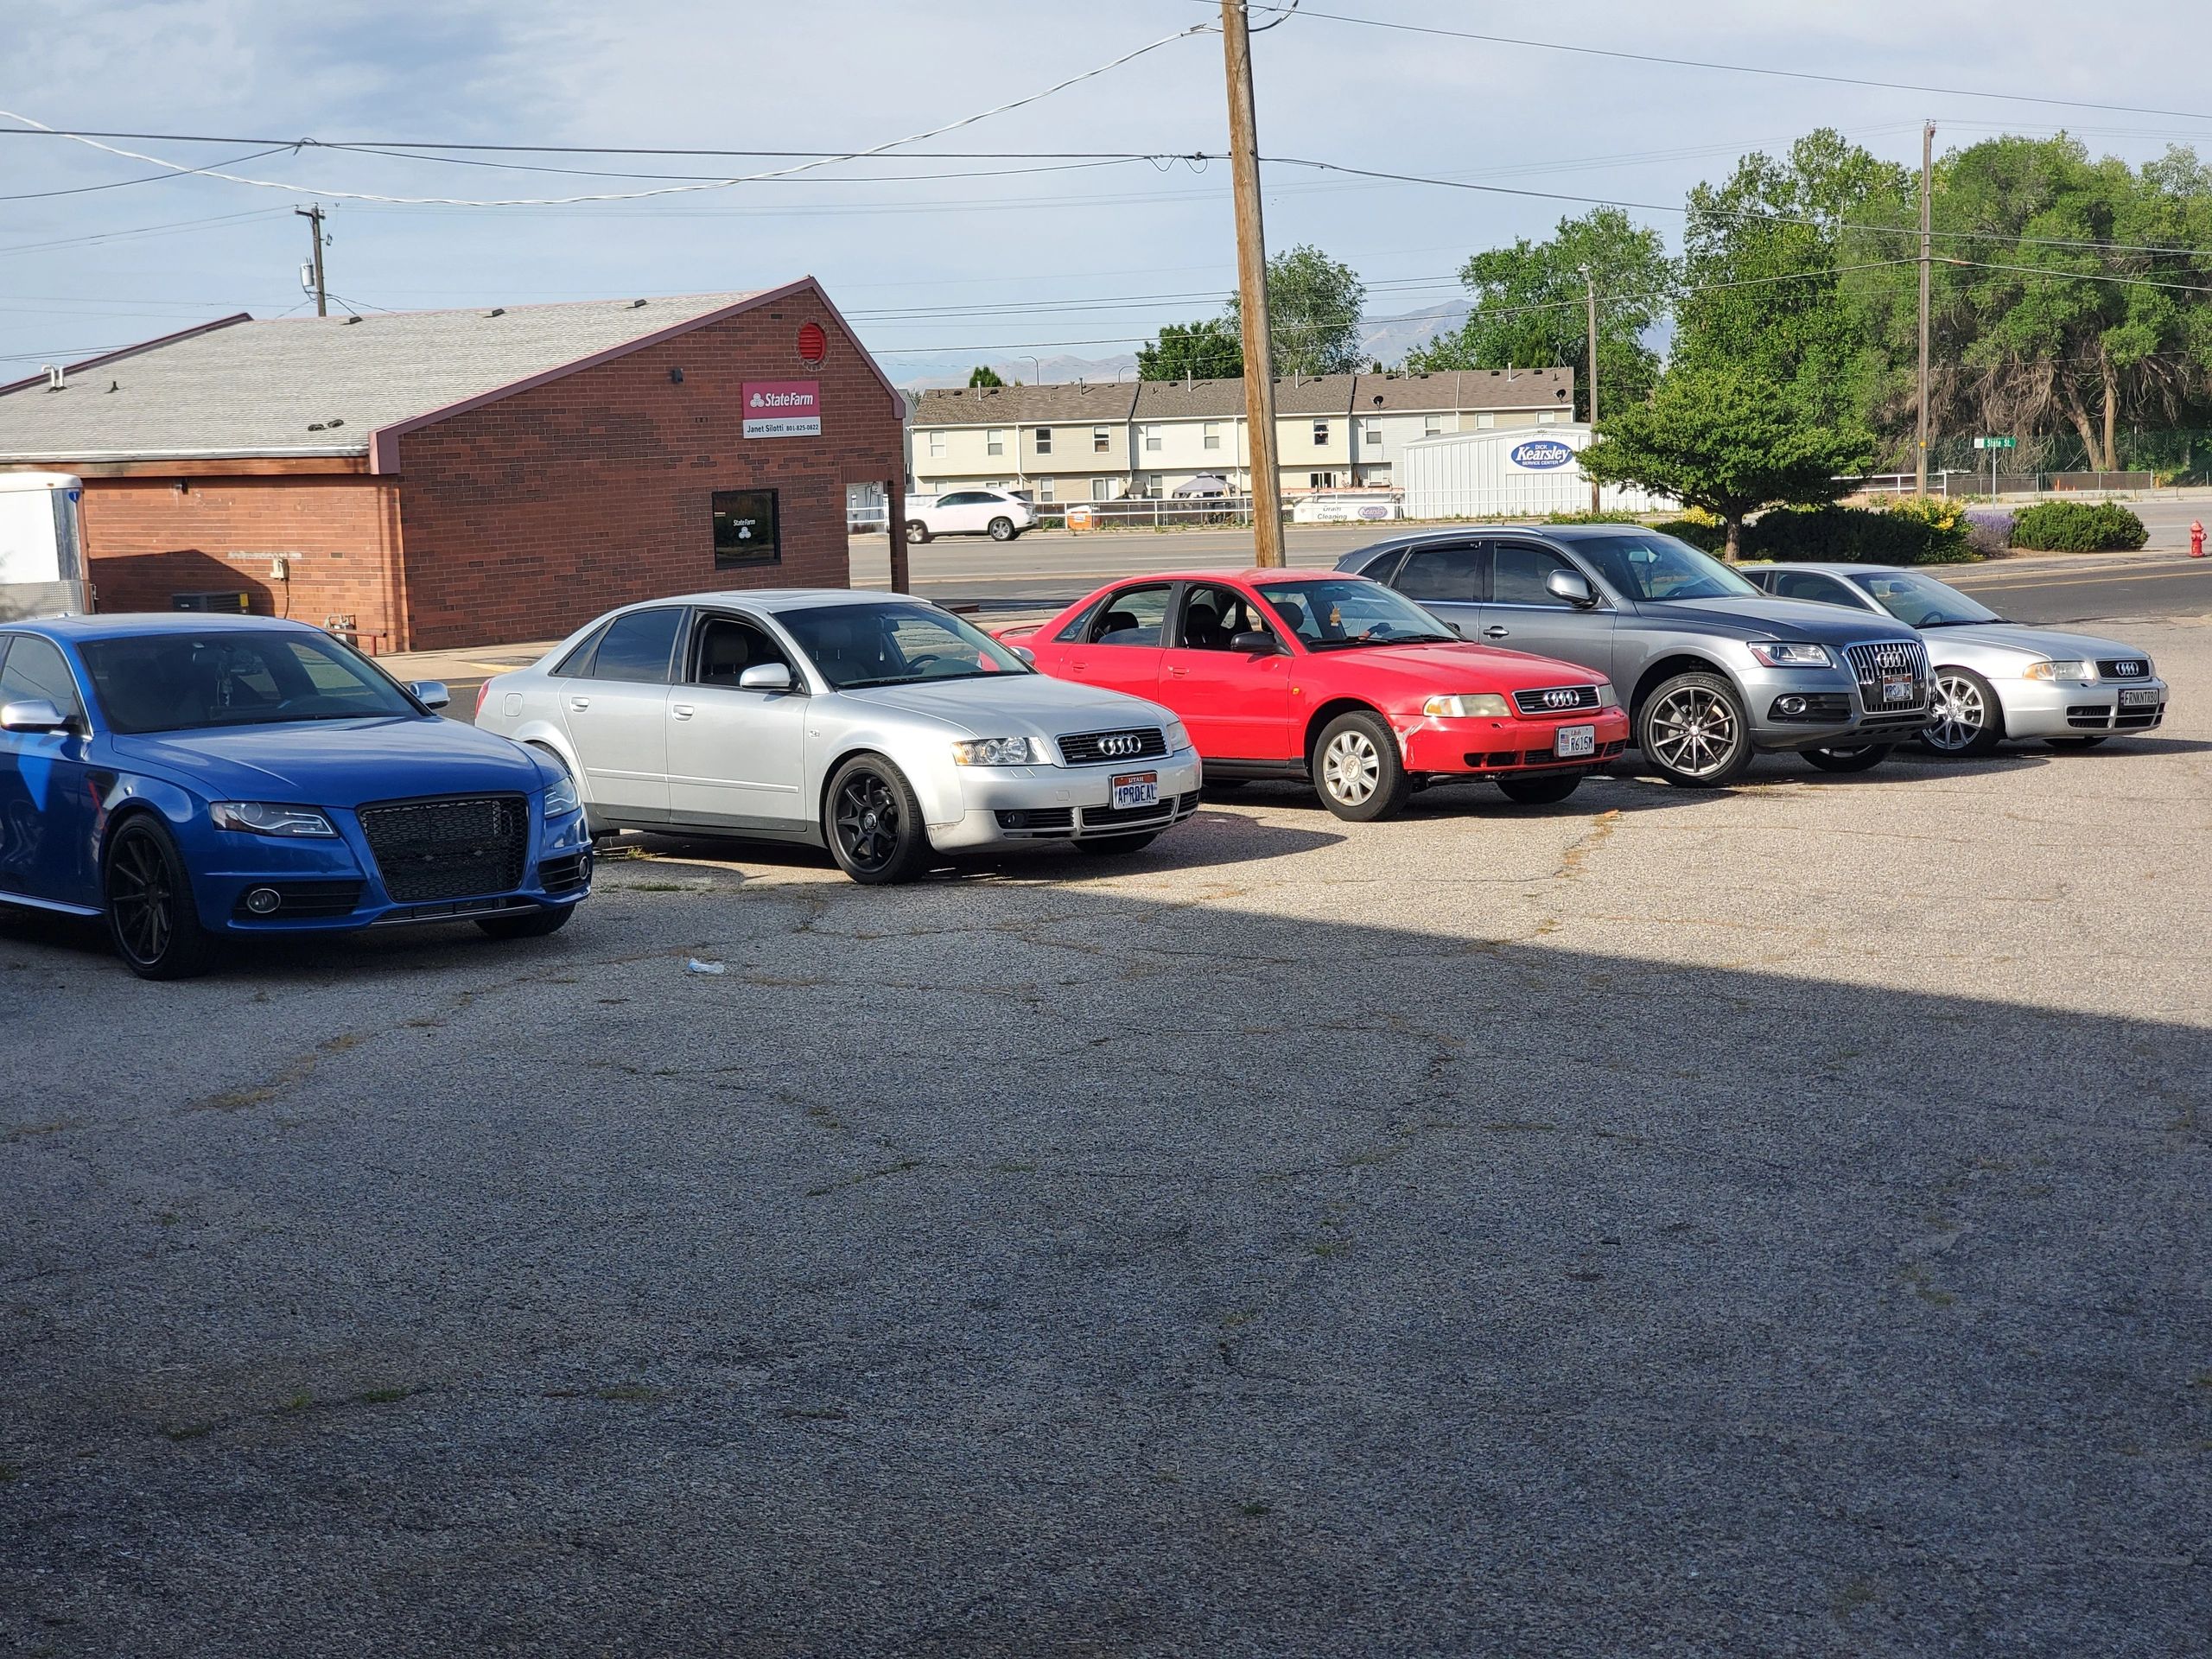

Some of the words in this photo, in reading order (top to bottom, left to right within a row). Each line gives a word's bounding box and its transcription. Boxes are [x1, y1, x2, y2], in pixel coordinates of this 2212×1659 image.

[747, 424, 765, 433] Janet
[1516, 446, 1570, 462] Kearsley
[1571, 735, 1593, 752] R615M
[1117, 784, 1157, 804] APRDEAL
